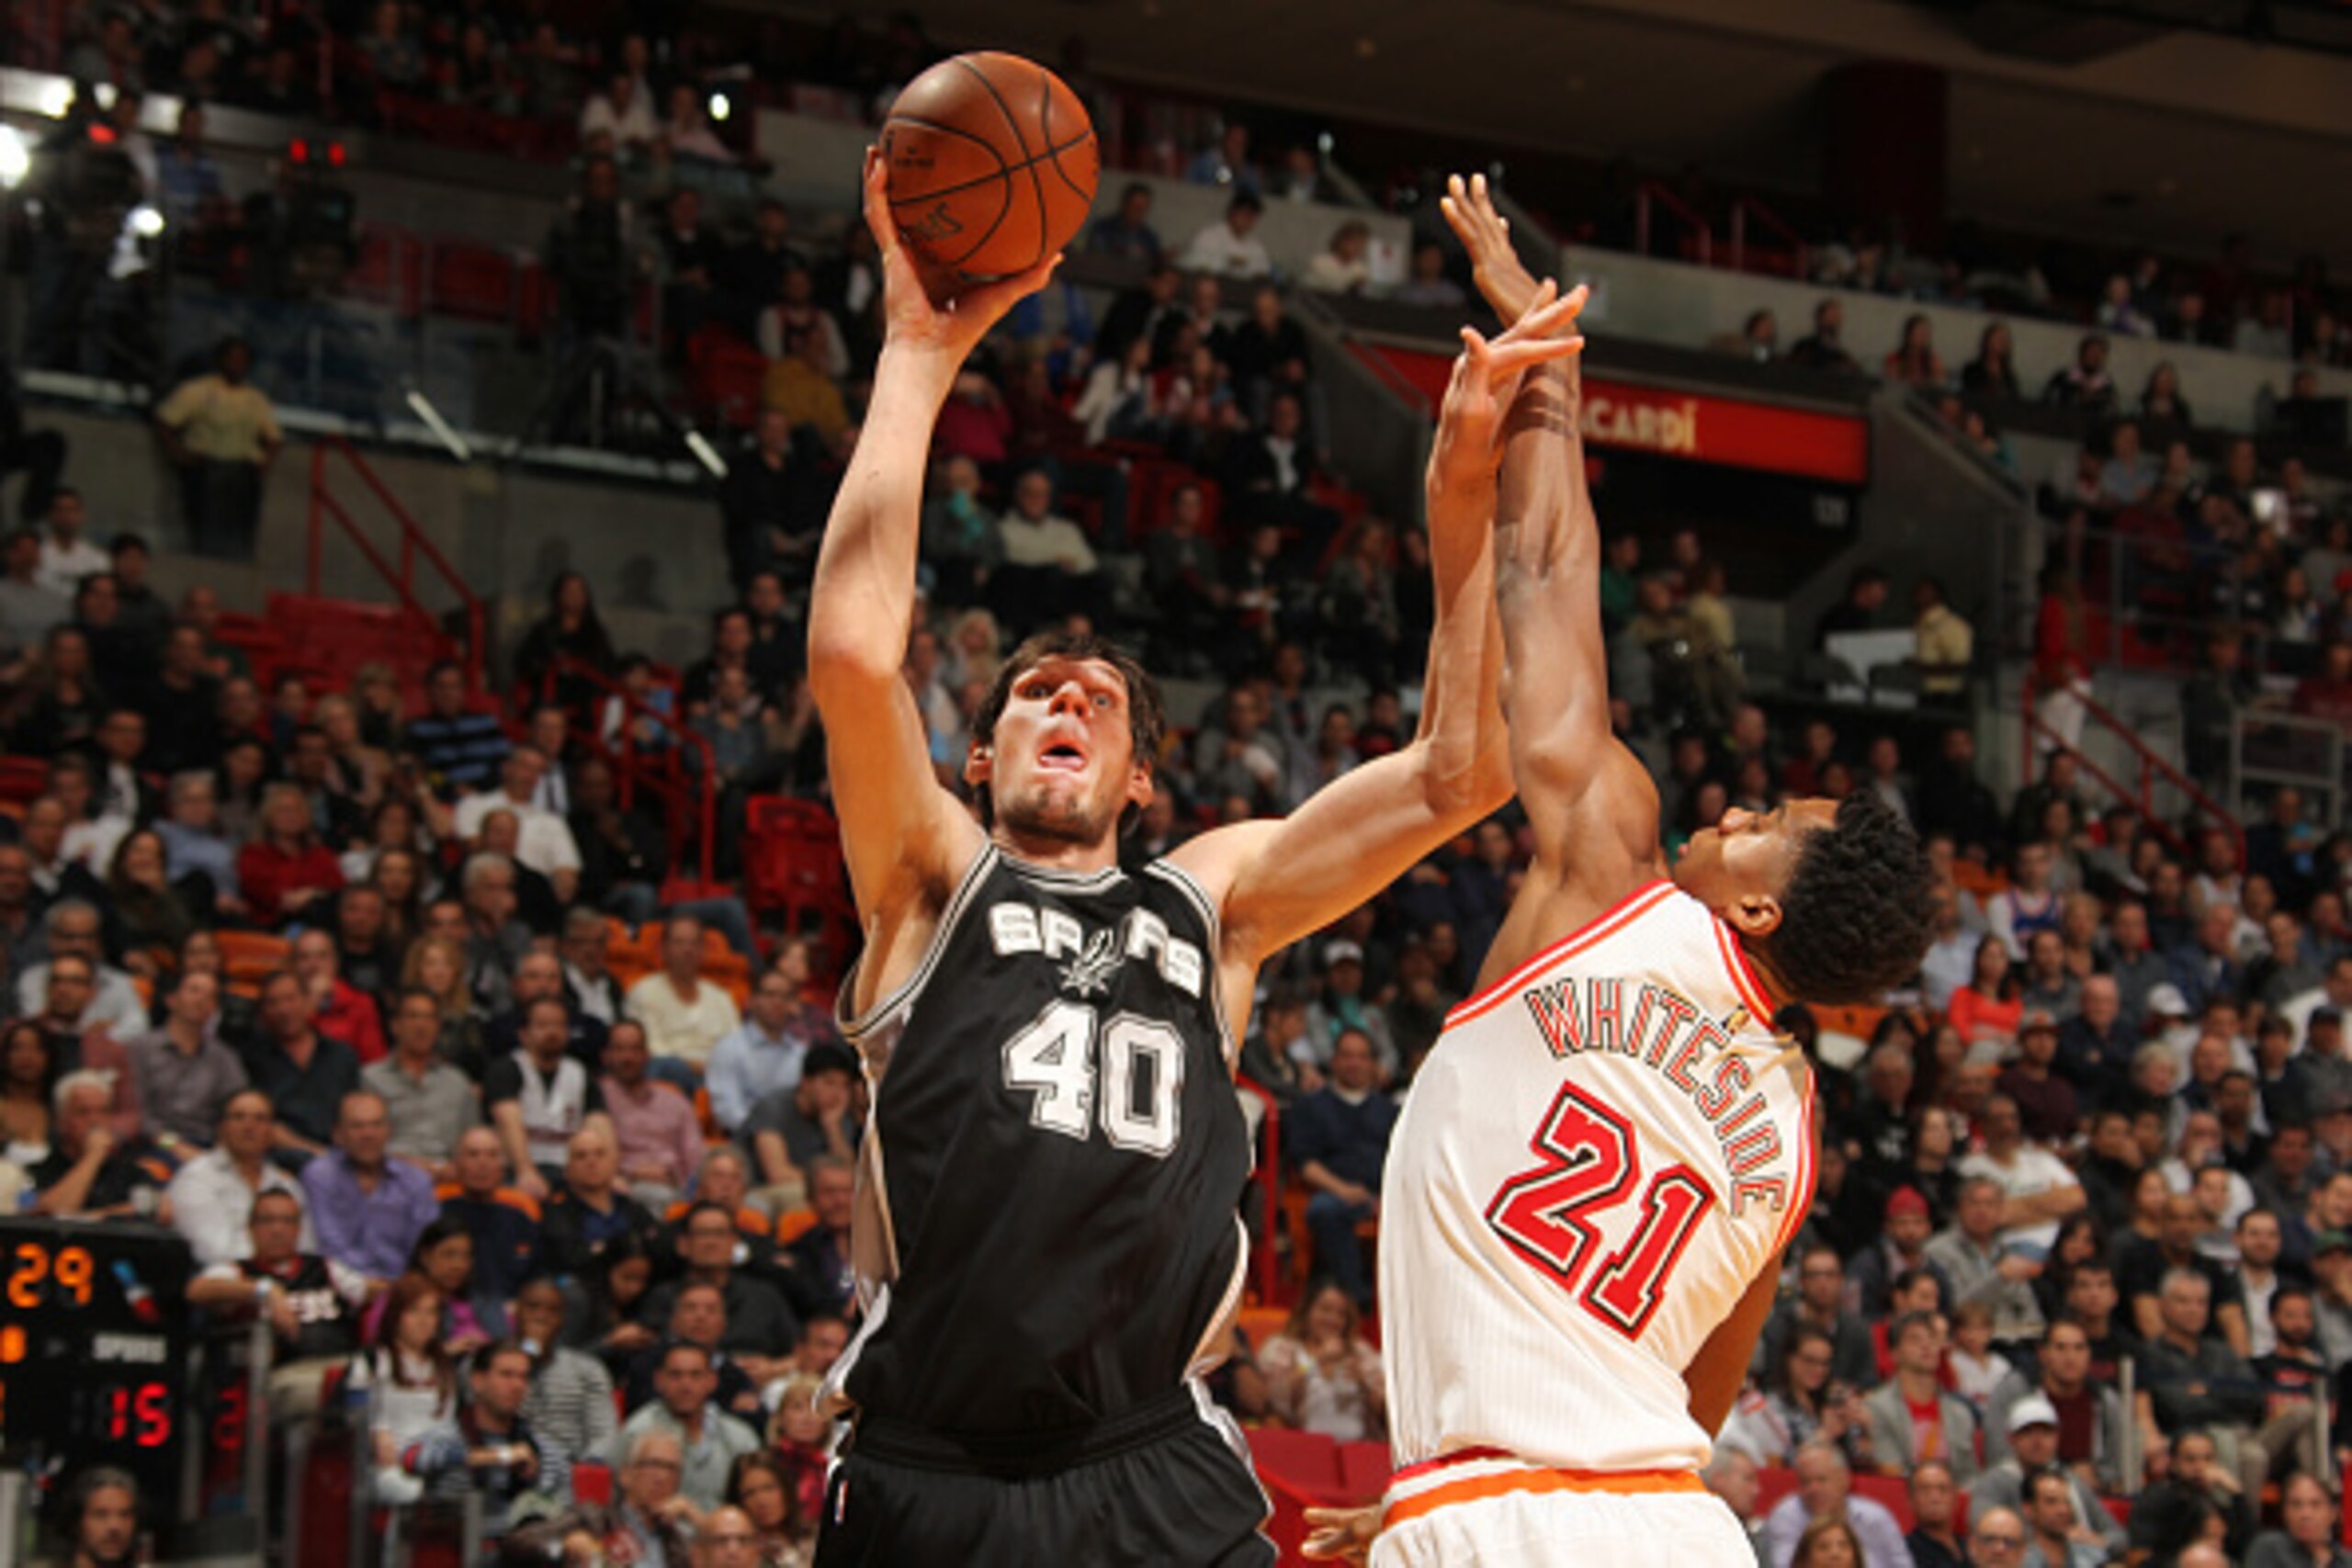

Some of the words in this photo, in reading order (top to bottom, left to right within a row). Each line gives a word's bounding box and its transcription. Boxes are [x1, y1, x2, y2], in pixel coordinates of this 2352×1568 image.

[1001, 998, 1185, 1159] 40
[1523, 977, 1788, 1218] WHITESIDE
[7, 1243, 94, 1308] 29
[1484, 1079, 1716, 1342] 21
[110, 1382, 172, 1447] 15
